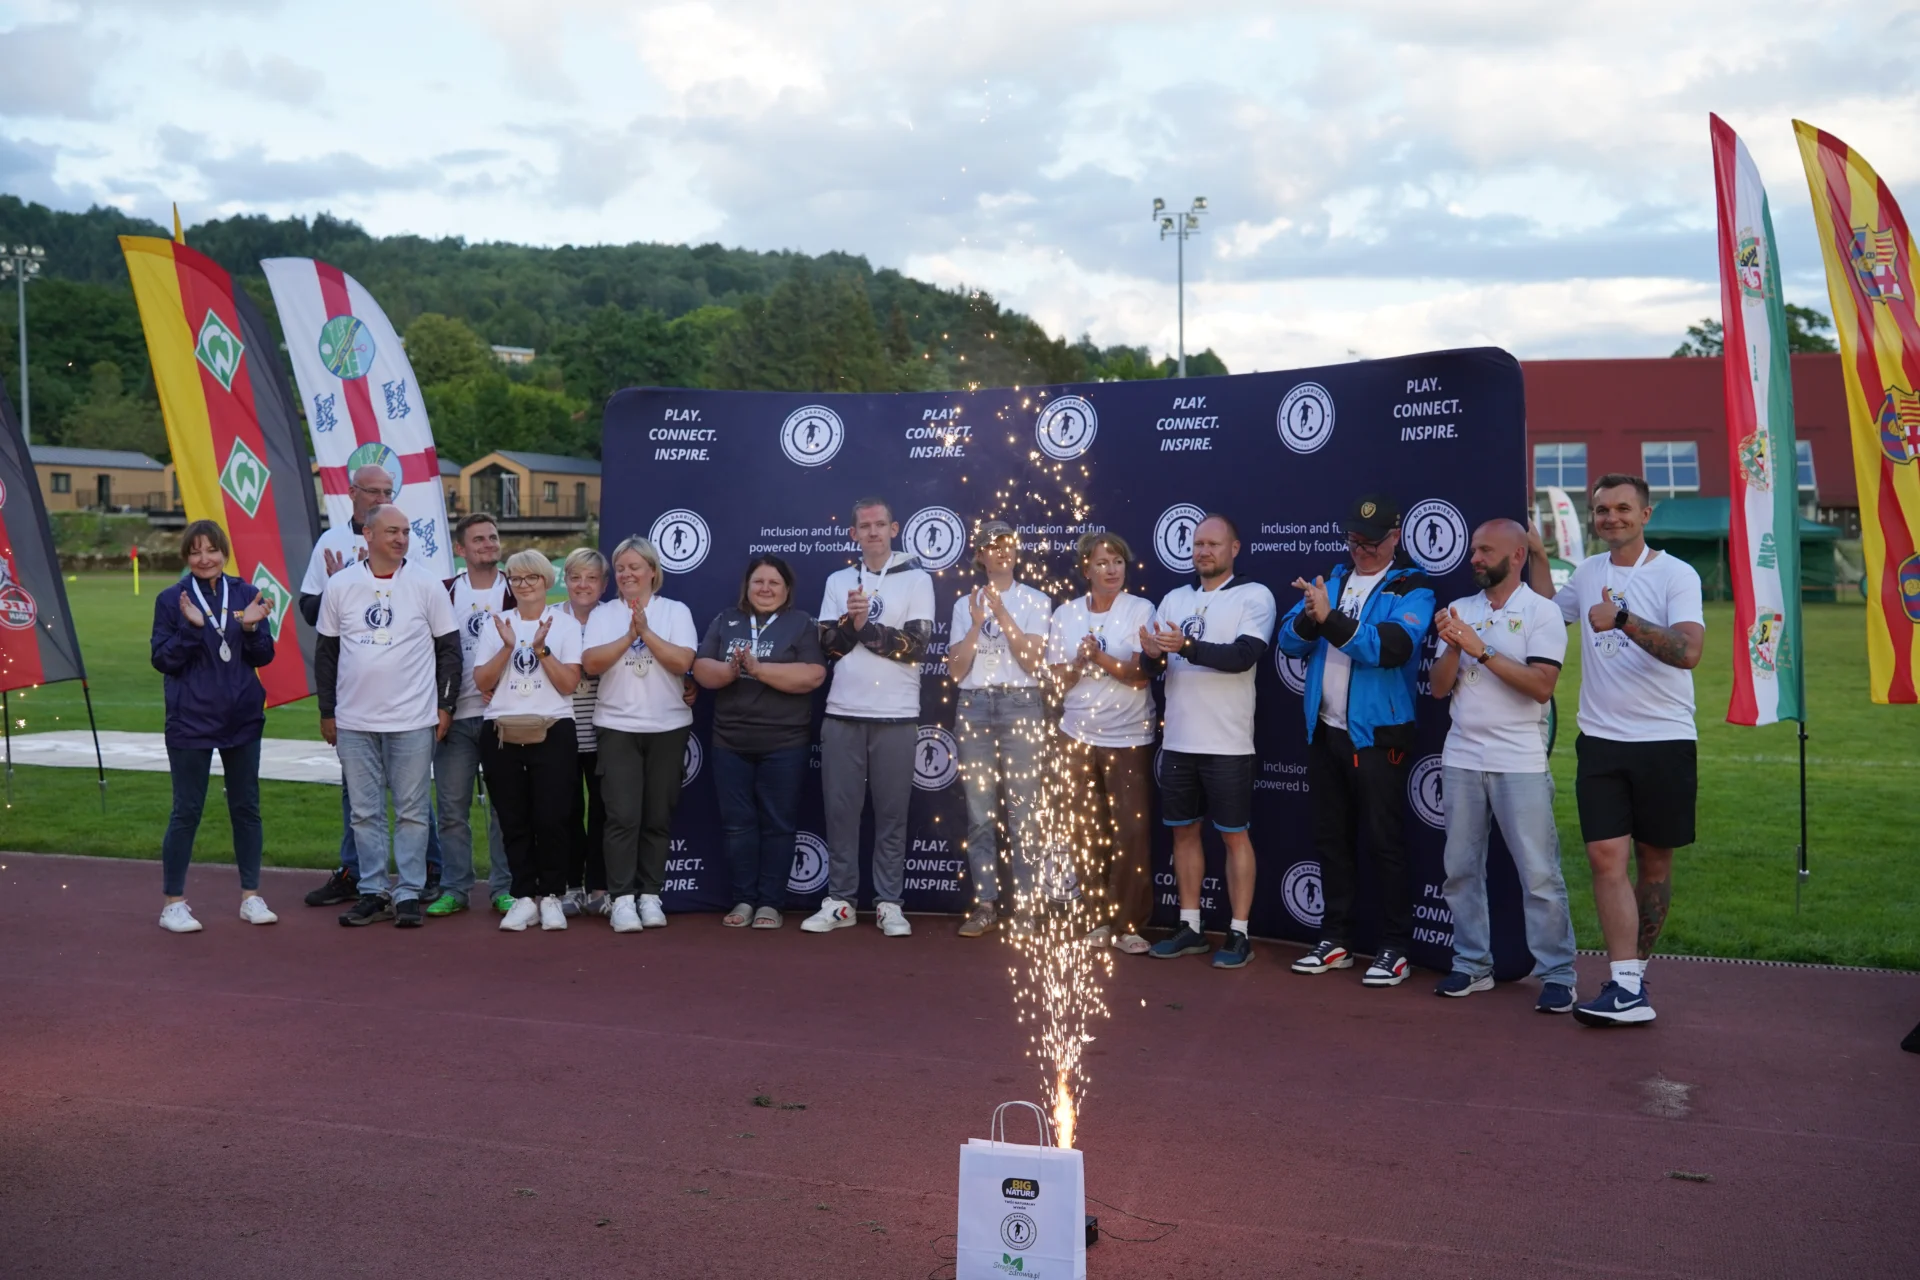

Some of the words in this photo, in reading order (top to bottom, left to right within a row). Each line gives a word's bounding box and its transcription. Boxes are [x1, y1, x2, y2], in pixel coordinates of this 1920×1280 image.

[1406, 377, 1442, 394] PLAY.
[1299, 388, 1324, 400] BARRIERS
[1172, 396, 1207, 410] PLAY.
[1393, 398, 1462, 418] CONNECT.
[664, 408, 702, 421] PLAY.
[922, 408, 960, 420] PLAY.
[1156, 416, 1220, 431] CONNECT.
[649, 428, 717, 442] CONNECT.
[905, 426, 973, 440] CONNECT.
[1400, 424, 1458, 442] INSPIRE.
[1160, 438, 1212, 451] INSPIRE.
[654, 448, 710, 461] INSPIRE.
[909, 445, 965, 458] INSPIRE.
[1413, 511, 1422, 520] NO
[1424, 504, 1455, 519] BARRIERS
[760, 526, 808, 536] inclusion
[811, 526, 831, 536] and
[1016, 523, 1062, 534] inclusion
[1065, 523, 1085, 534] and
[1088, 523, 1106, 534] fun
[1261, 522, 1307, 534] inclusion
[1309, 522, 1329, 534] and
[749, 542, 797, 555] powered
[799, 542, 813, 555] by
[1020, 540, 1051, 551] wered
[1054, 540, 1067, 553] by
[1251, 540, 1296, 554] powered
[1299, 540, 1312, 555] by
[1314, 540, 1349, 551] footbA
[1254, 780, 1299, 791] powered
[1302, 781, 1310, 792] b
[669, 839, 687, 851] AY.
[912, 840, 949, 852] PLAY.
[664, 858, 704, 871] NECT.
[903, 858, 966, 873] ONNECT.
[660, 878, 698, 892] PIRE.
[904, 877, 961, 891] INSPIRE.
[1154, 872, 1221, 890] COCT.
[1012, 1180, 1032, 1190] BIG
[1006, 1188, 1035, 1197] NATURE
